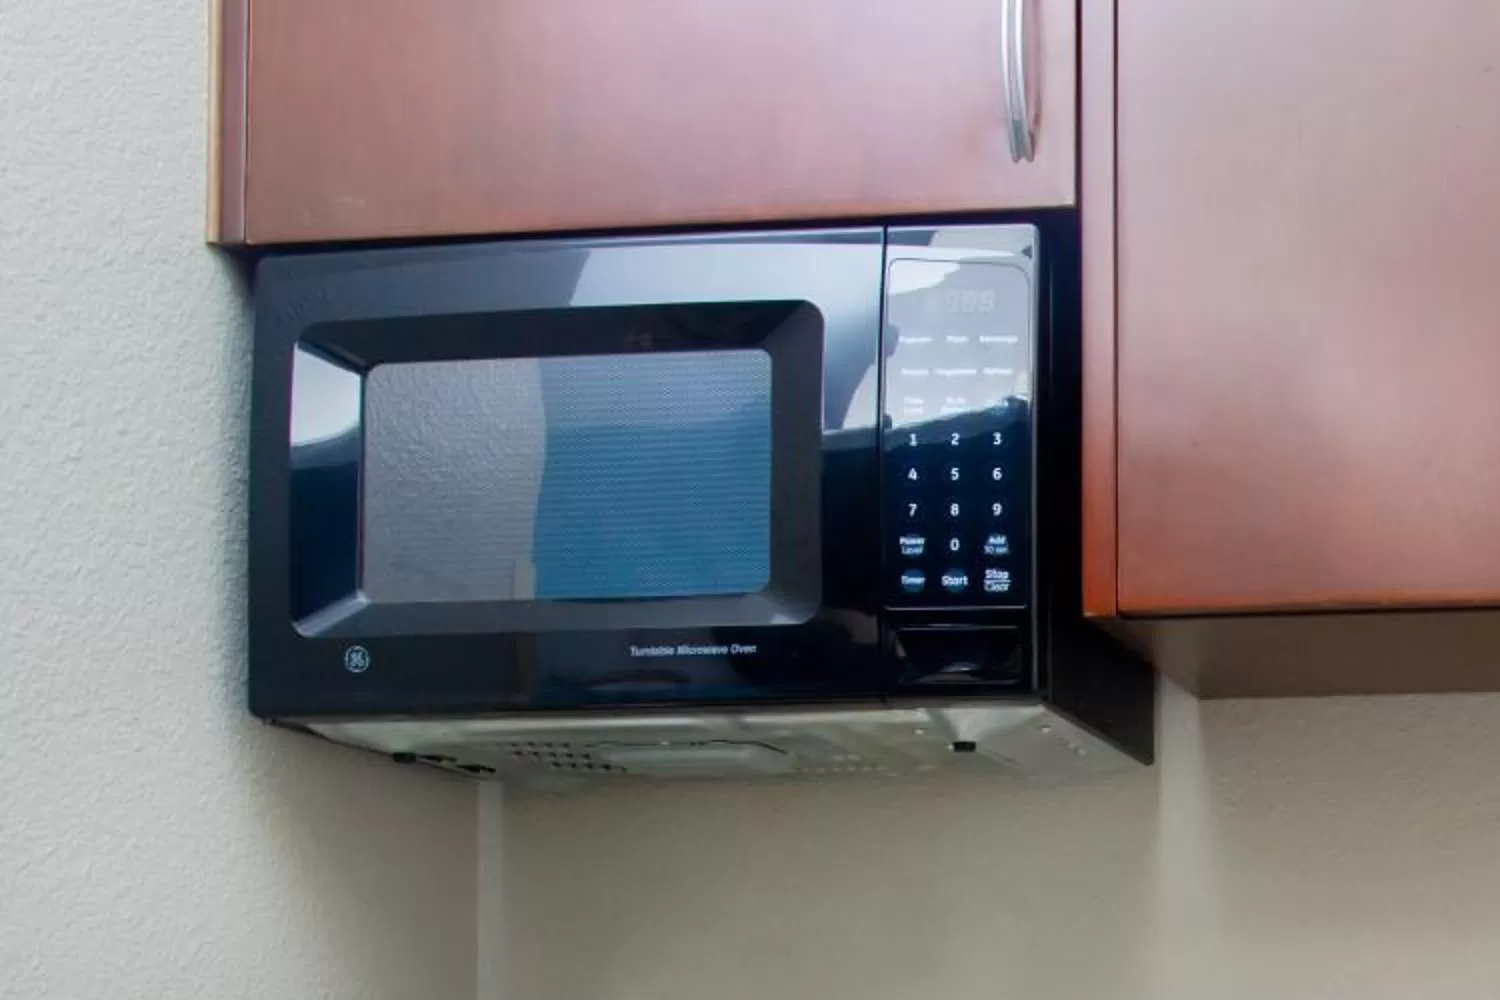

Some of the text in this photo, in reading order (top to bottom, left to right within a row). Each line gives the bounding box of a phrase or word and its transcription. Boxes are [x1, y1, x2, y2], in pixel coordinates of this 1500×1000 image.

[908, 432, 1002, 447] 1 2 3
[907, 467, 1003, 481] 4 5 6
[908, 503, 1002, 517] 7 8 9
[950, 537, 960, 551] 0
[941, 575, 969, 587] Start
[729, 643, 757, 655] Oven
